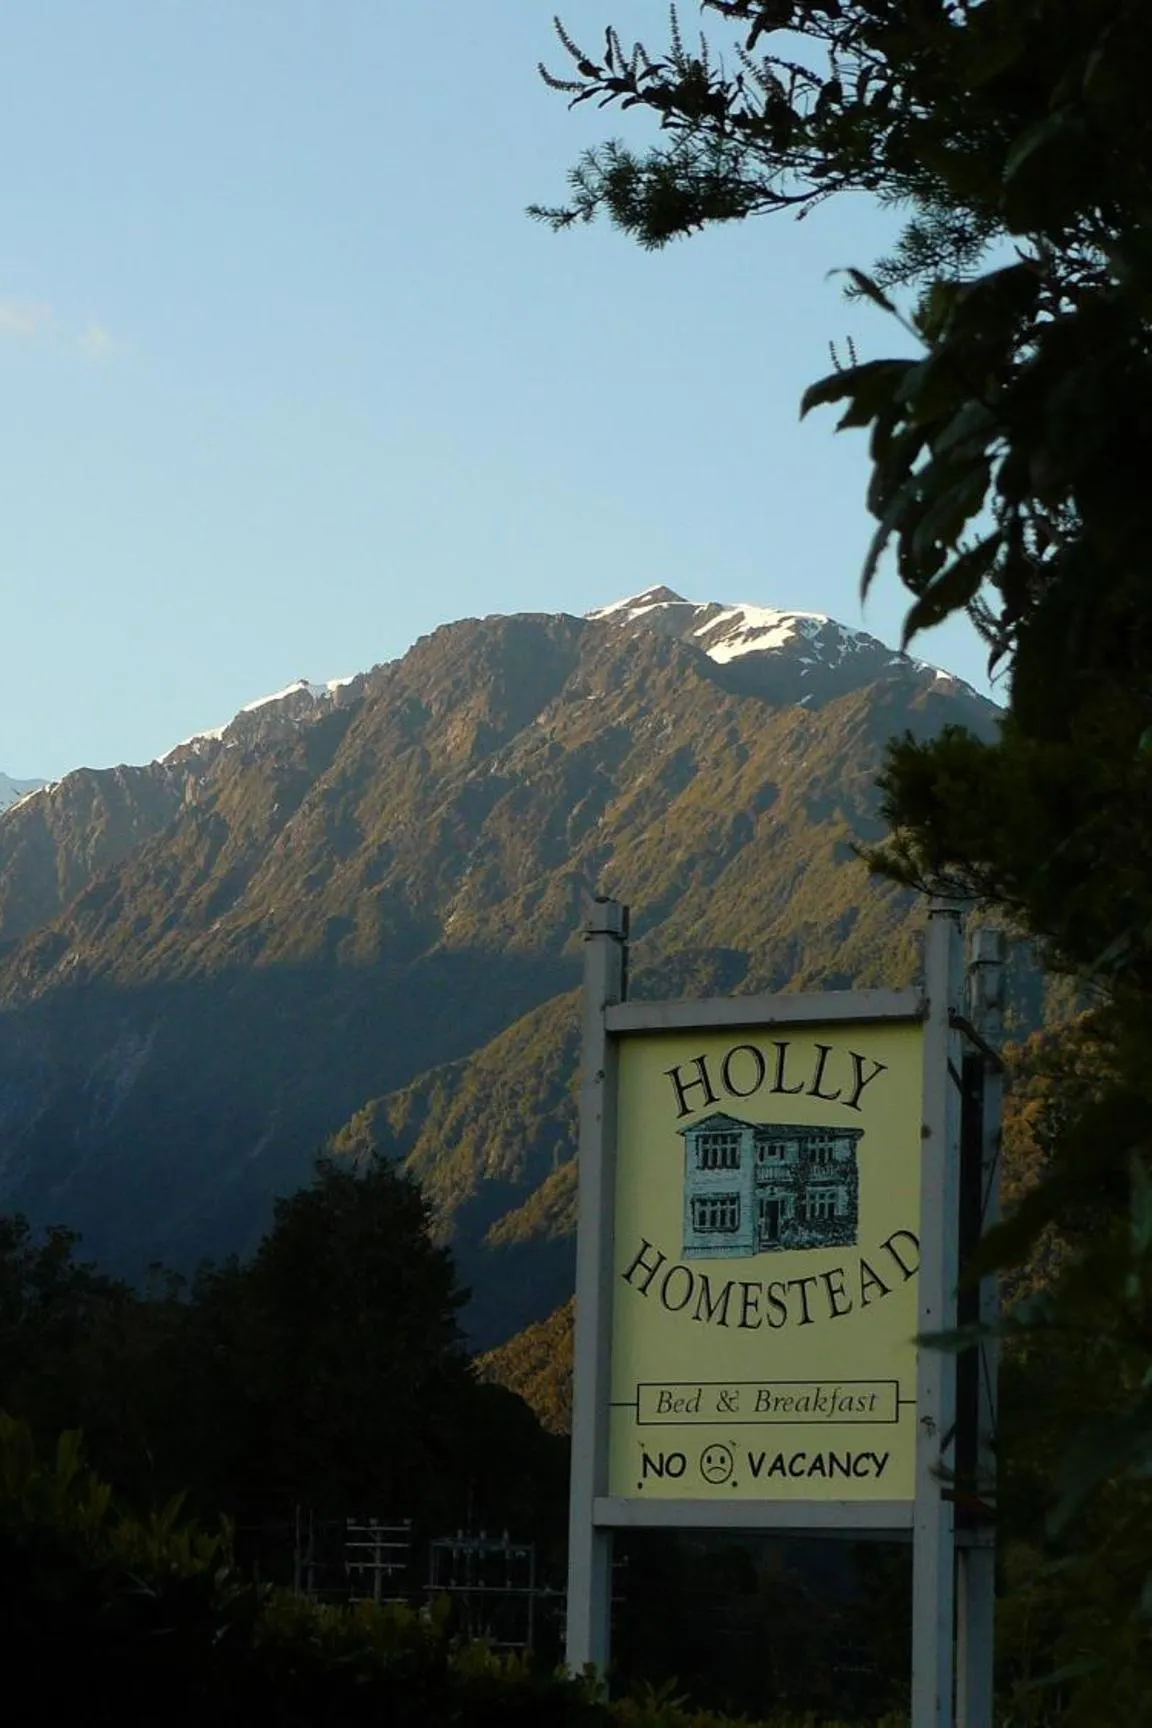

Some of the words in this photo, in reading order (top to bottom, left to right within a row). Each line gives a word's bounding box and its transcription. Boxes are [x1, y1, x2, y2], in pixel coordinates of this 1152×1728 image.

[664, 1041, 888, 1119] HOLLY
[621, 1229, 921, 1329] HOMESTEAD
[656, 1387, 702, 1413] Bed
[716, 1390, 740, 1412] &
[754, 1387, 878, 1417] Breakfast
[642, 1452, 687, 1478] NO
[748, 1451, 890, 1478] VACANCY
